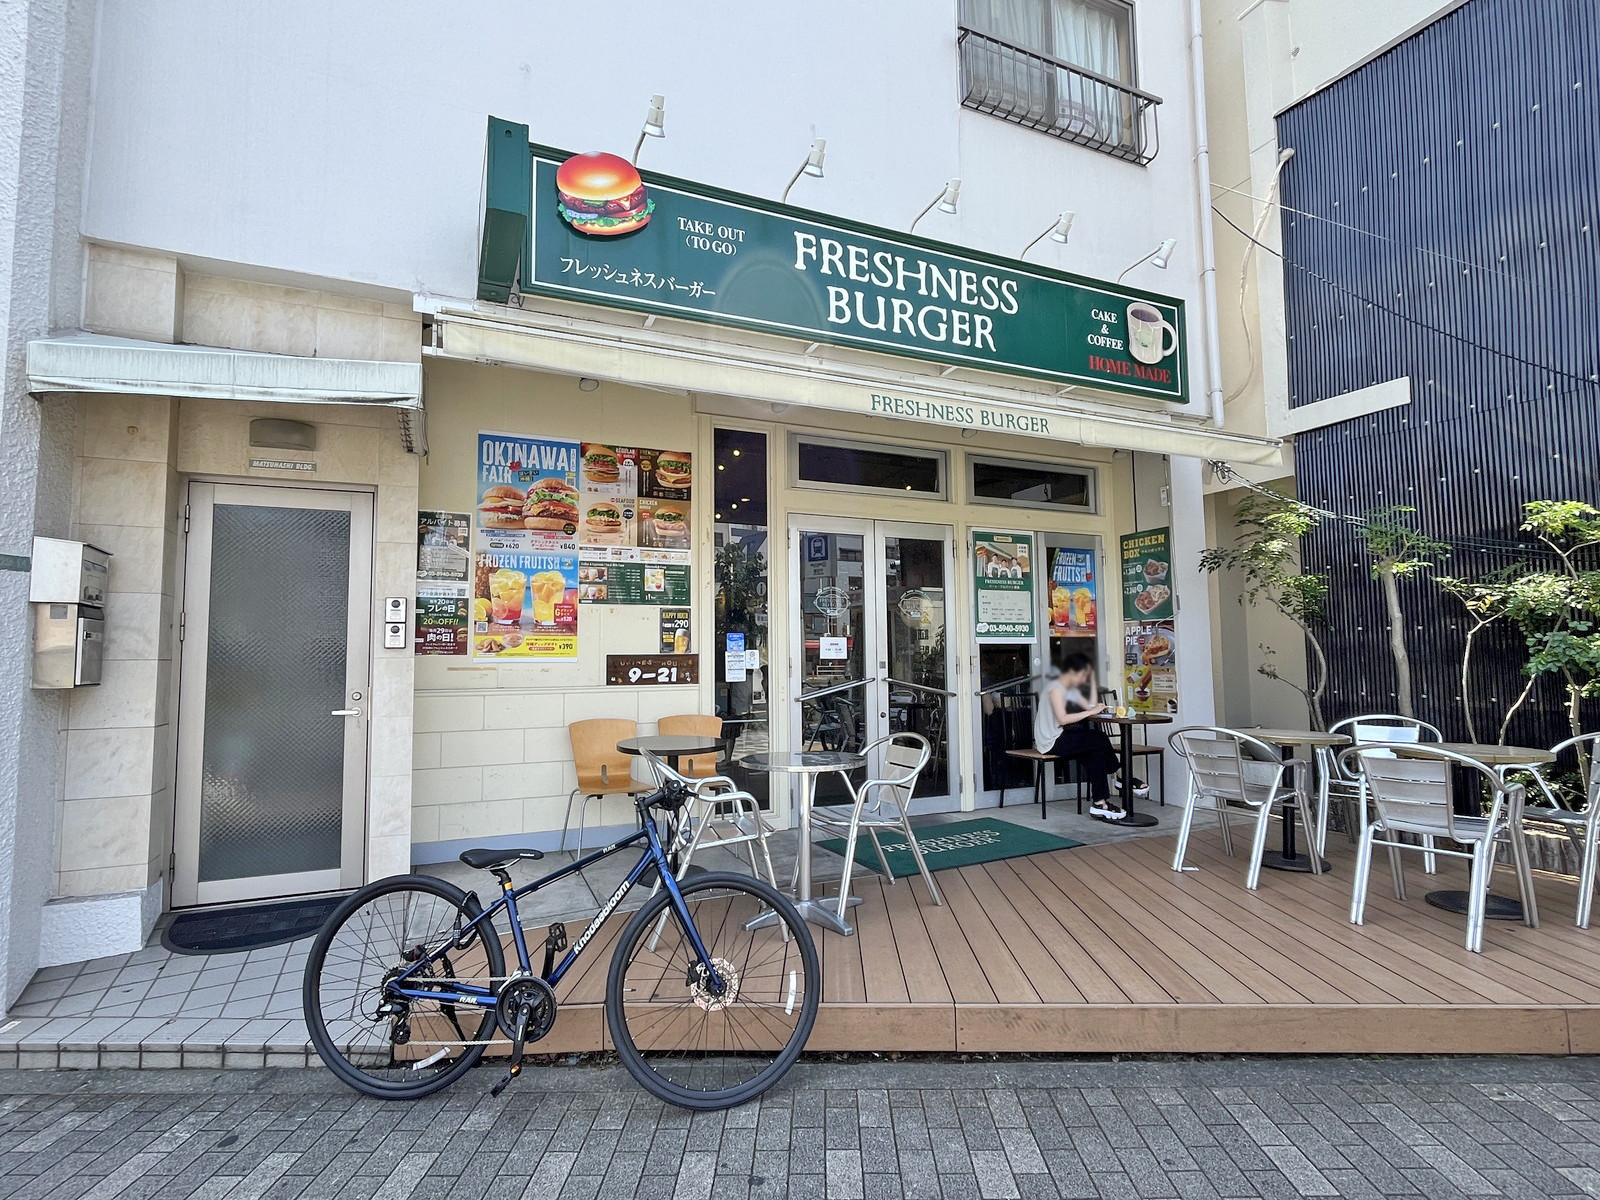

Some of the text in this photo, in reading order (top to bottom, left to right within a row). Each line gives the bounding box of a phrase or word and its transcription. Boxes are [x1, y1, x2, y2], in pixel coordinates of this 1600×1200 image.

[677, 216, 746, 243] TAKE OUT
[559, 256, 717, 299] フレッシュネスバーガー
[793, 230, 1020, 316] FRESHNESS
[826, 285, 998, 353] BURGER
[1090, 308, 1118, 325] CAKE
[1101, 323, 1110, 335] &
[1087, 333, 1124, 352] COFFEE
[1088, 354, 1172, 385] HOME MADE
[870, 393, 1050, 435] FRESHNESS BURGER
[481, 439, 570, 472] OKINAWA
[615, 447, 636, 455] REGULAR
[252, 460, 294, 469] MATSUHASHI
[481, 464, 513, 484] FAIR
[419, 517, 468, 528] アルバイト募集
[1122, 533, 1166, 550] CHICKEN
[479, 553, 518, 569] FROZEN
[519, 555, 554, 570] FRUITS
[1055, 552, 1077, 566] FROZEN
[1123, 548, 1141, 560] BOX
[1052, 565, 1081, 583] FRUITS
[427, 604, 456, 613] フレの日
[988, 624, 1030, 633] 03-5940-5930
[1125, 625, 1152, 636] APPLE
[426, 632, 454, 643] 肉の日!
[1125, 636, 1138, 646] PIE
[459, 996, 478, 1005] RAIL
